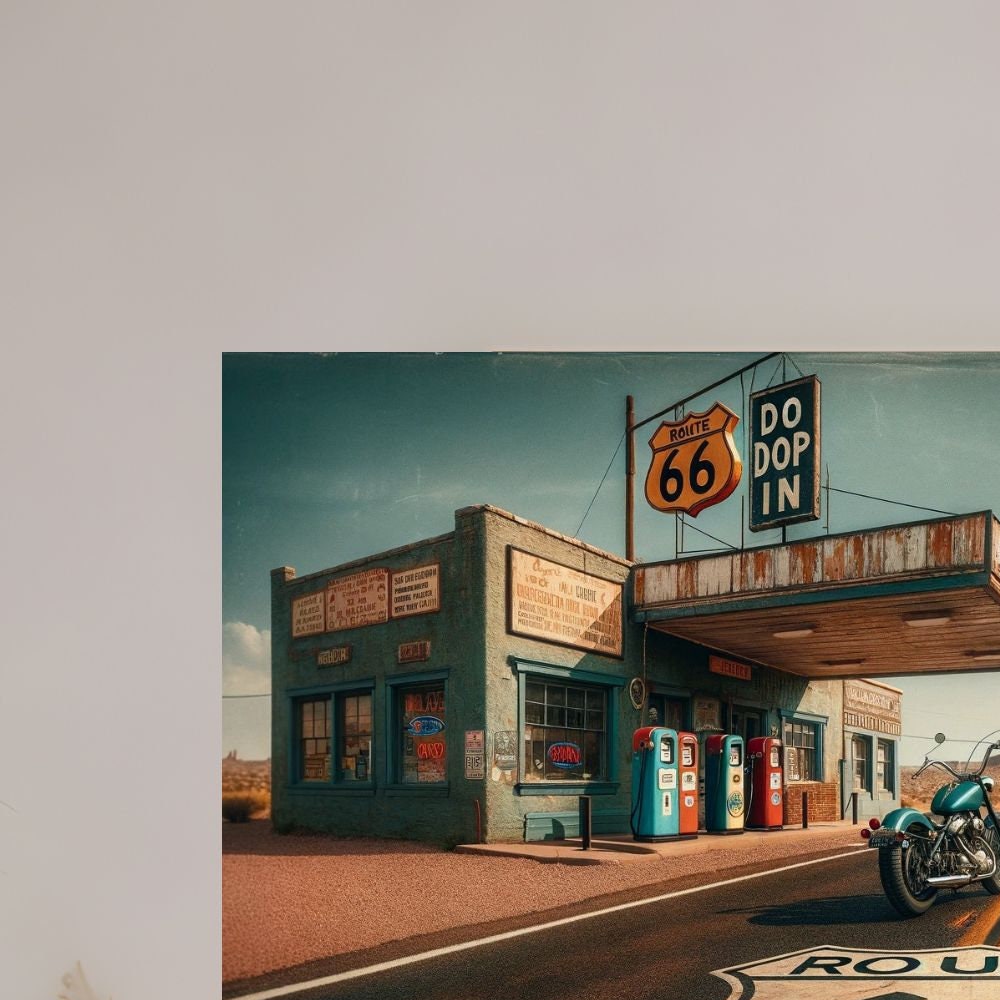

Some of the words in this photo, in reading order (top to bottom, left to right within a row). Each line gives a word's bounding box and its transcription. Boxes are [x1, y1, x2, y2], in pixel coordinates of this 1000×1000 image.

[669, 418, 710, 442] ROUTE
[761, 397, 802, 437] DO
[659, 440, 715, 503] 66
[754, 431, 811, 478] DOP
[763, 475, 800, 515] IN
